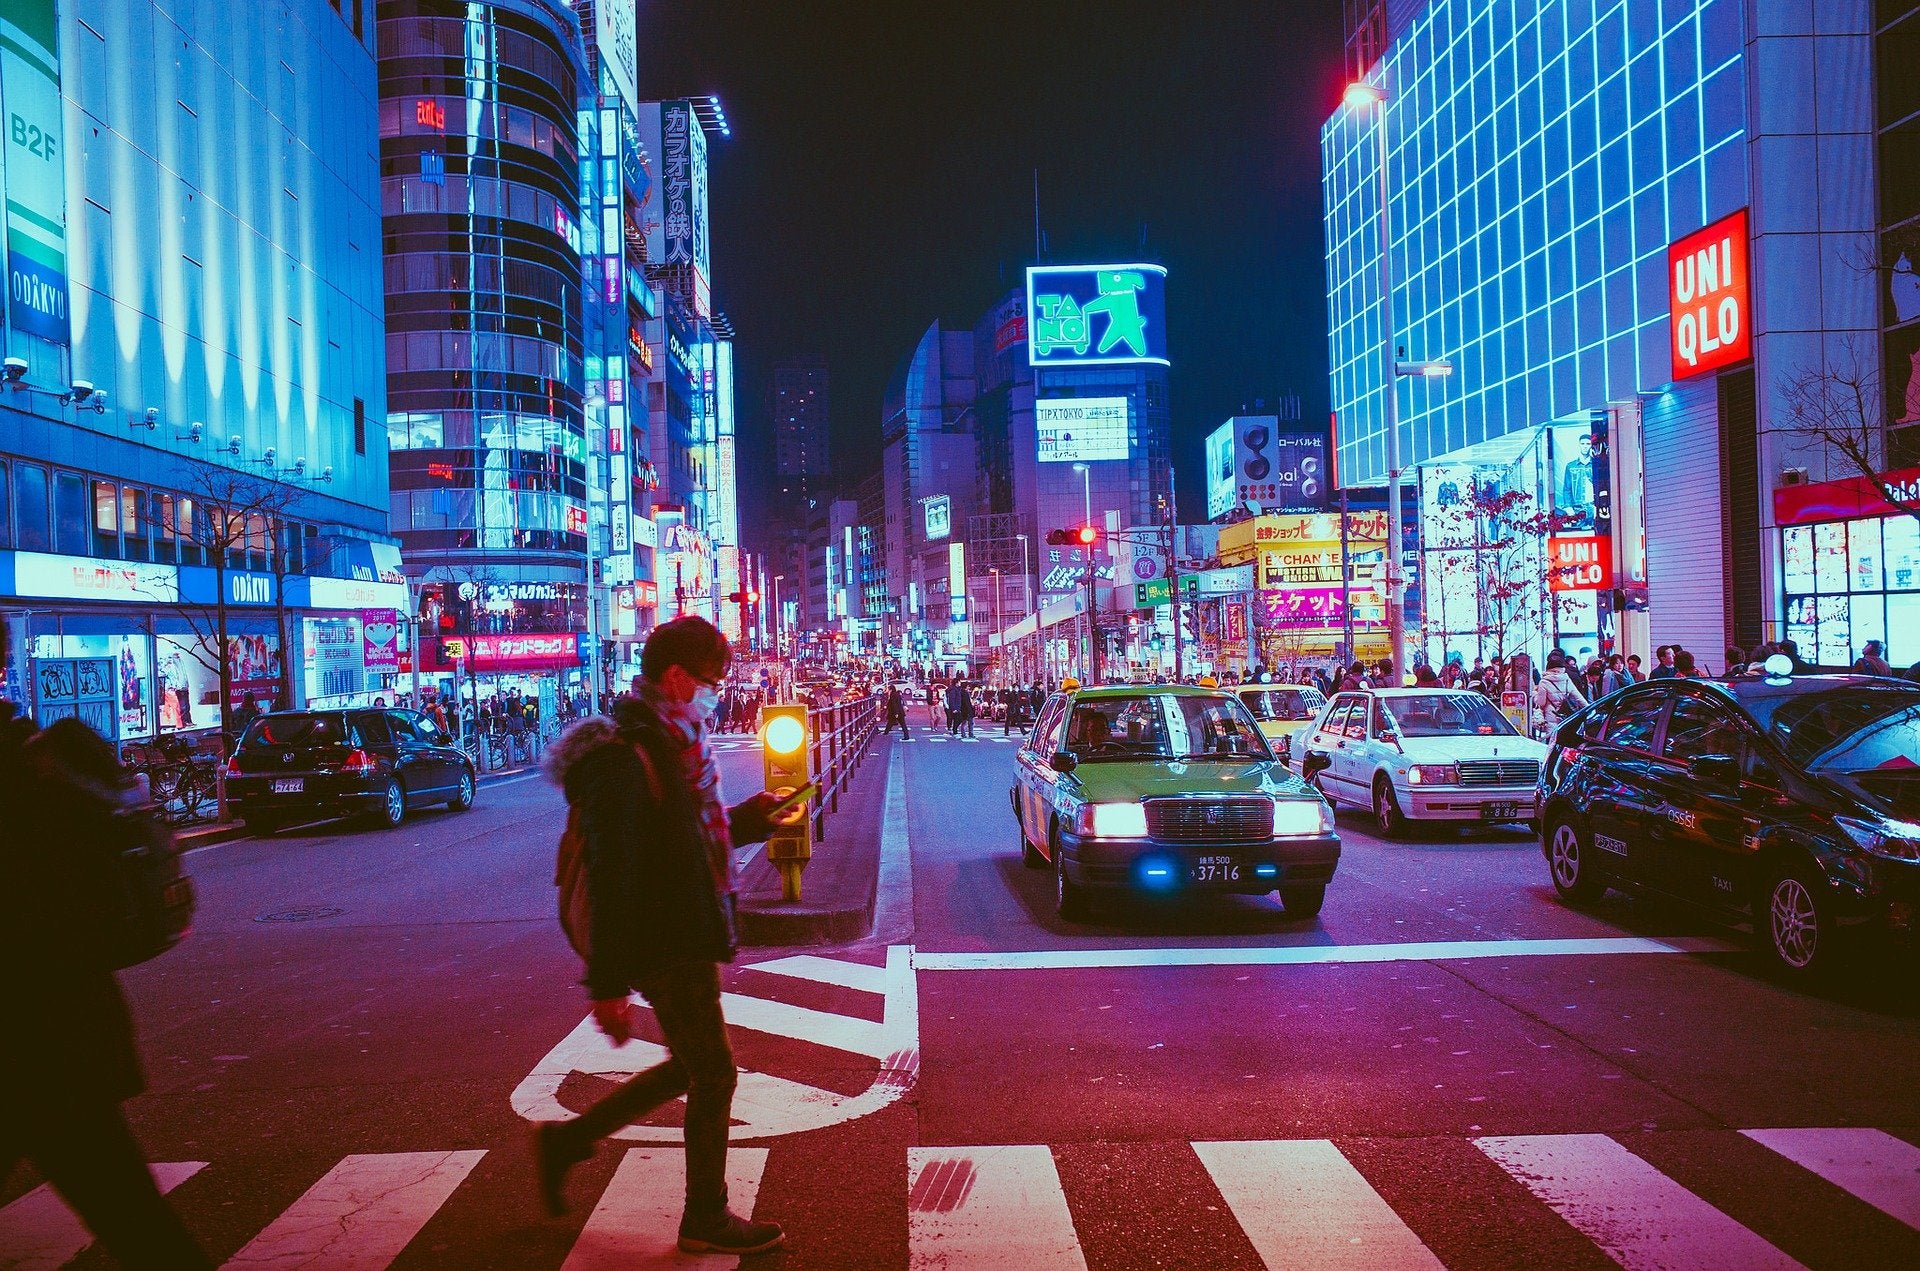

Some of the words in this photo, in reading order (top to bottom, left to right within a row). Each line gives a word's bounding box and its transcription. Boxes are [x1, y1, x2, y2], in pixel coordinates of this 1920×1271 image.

[11, 112, 56, 162] B2F
[665, 106, 692, 264] カラオケの鉄人
[1675, 238, 1732, 304] UNI
[1038, 318, 1086, 342] NO
[1678, 296, 1739, 366] QLO
[1560, 543, 1598, 562] UNI
[1282, 573, 1317, 583] UNION
[1266, 591, 1343, 613] チケット
[1229, 606, 1239, 639] チケット
[499, 638, 563, 655] サンドラッグ
[1216, 855, 1230, 865] 500
[1711, 875, 1732, 893] TAXI
